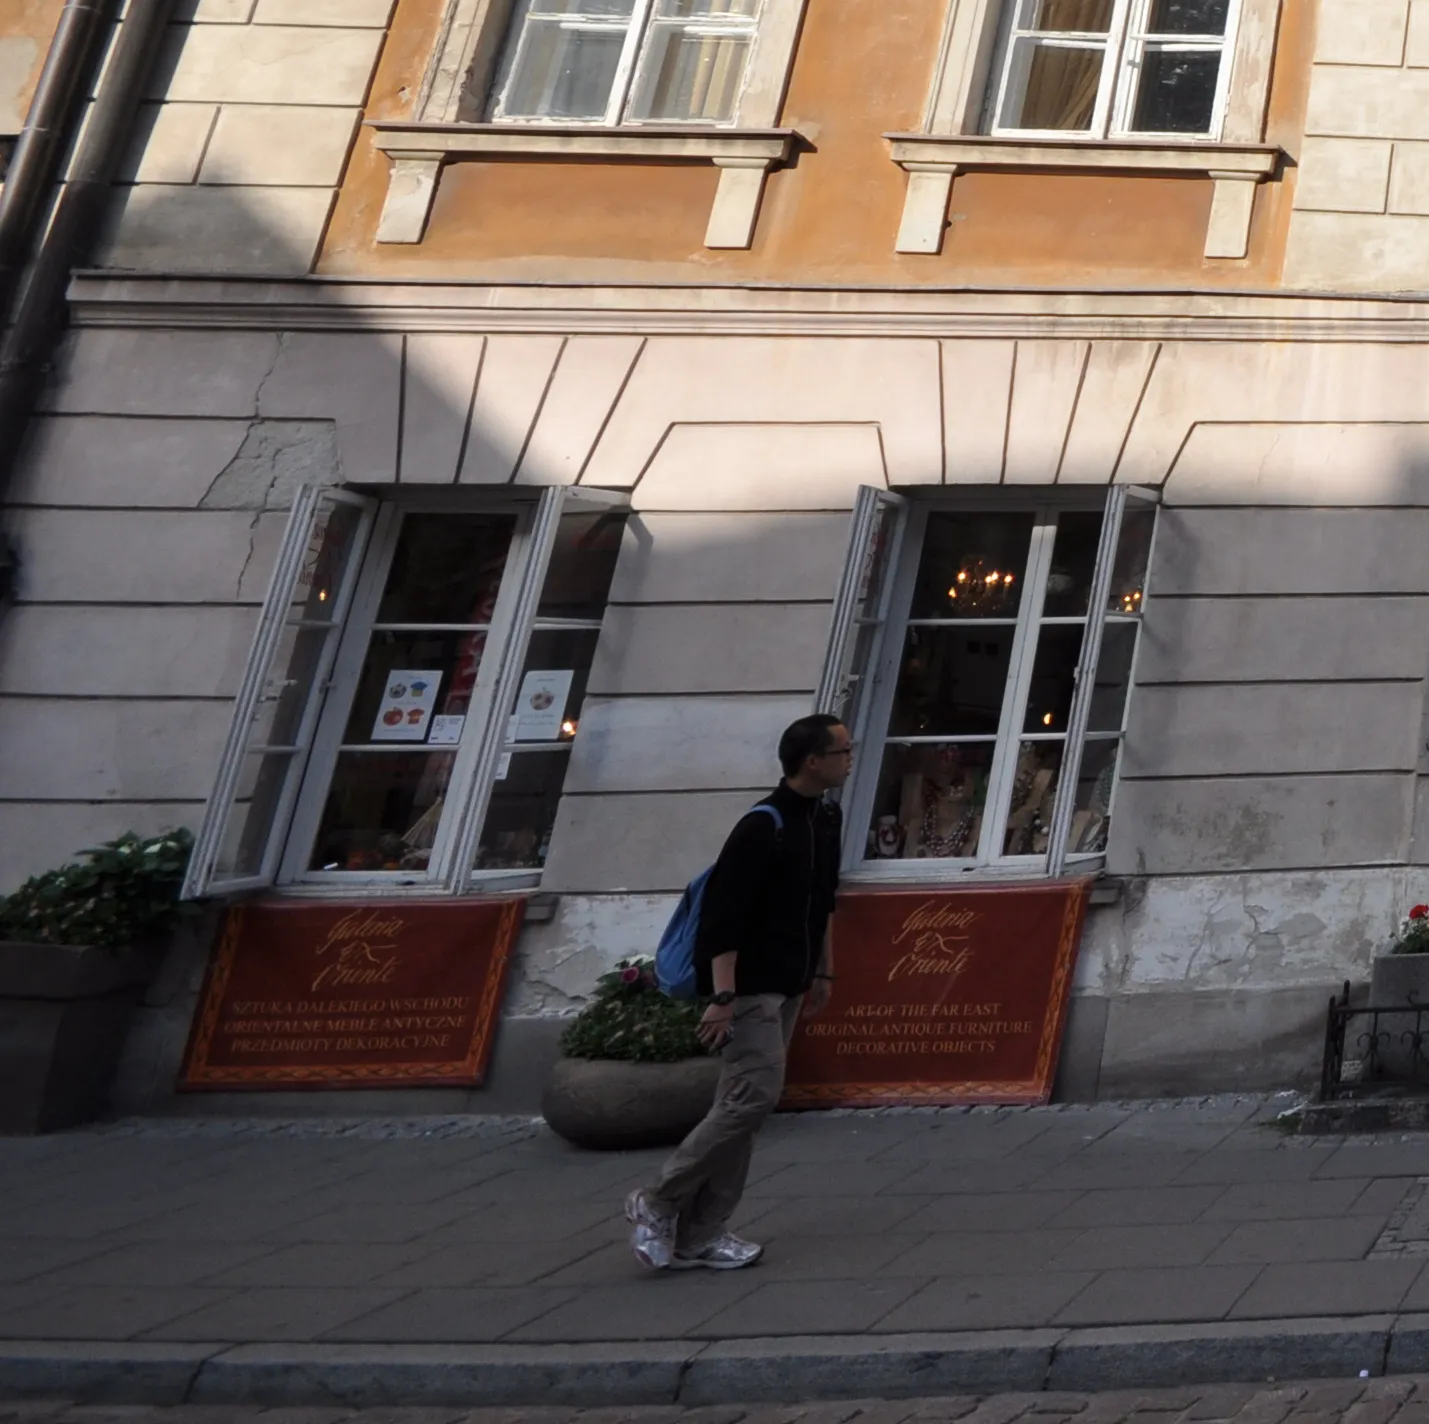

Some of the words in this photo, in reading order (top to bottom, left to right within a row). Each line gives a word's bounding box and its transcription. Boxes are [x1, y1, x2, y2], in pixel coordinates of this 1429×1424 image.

[233, 1000, 293, 1015] SZTUKA
[296, 998, 386, 1014] DALEKIEGO
[389, 996, 469, 1012] WSCHODU
[900, 1004, 928, 1016] THE
[932, 1003, 959, 1016] FAR
[963, 1002, 1002, 1016] EAST
[224, 1018, 322, 1033] ORIENTALNE
[326, 1017, 378, 1032] MEBLE
[382, 1015, 466, 1030] ANTYCZNE
[805, 1022, 878, 1036] ORIGINAL
[881, 1022, 946, 1036] ANTIQUE
[949, 1020, 1033, 1034] FURNITURE
[231, 1037, 332, 1052] PRZEDMIOTY
[336, 1034, 452, 1051] DEKORACYJNE
[836, 1040, 929, 1055] DECORATIVE
[932, 1040, 996, 1054] OBJECTS
